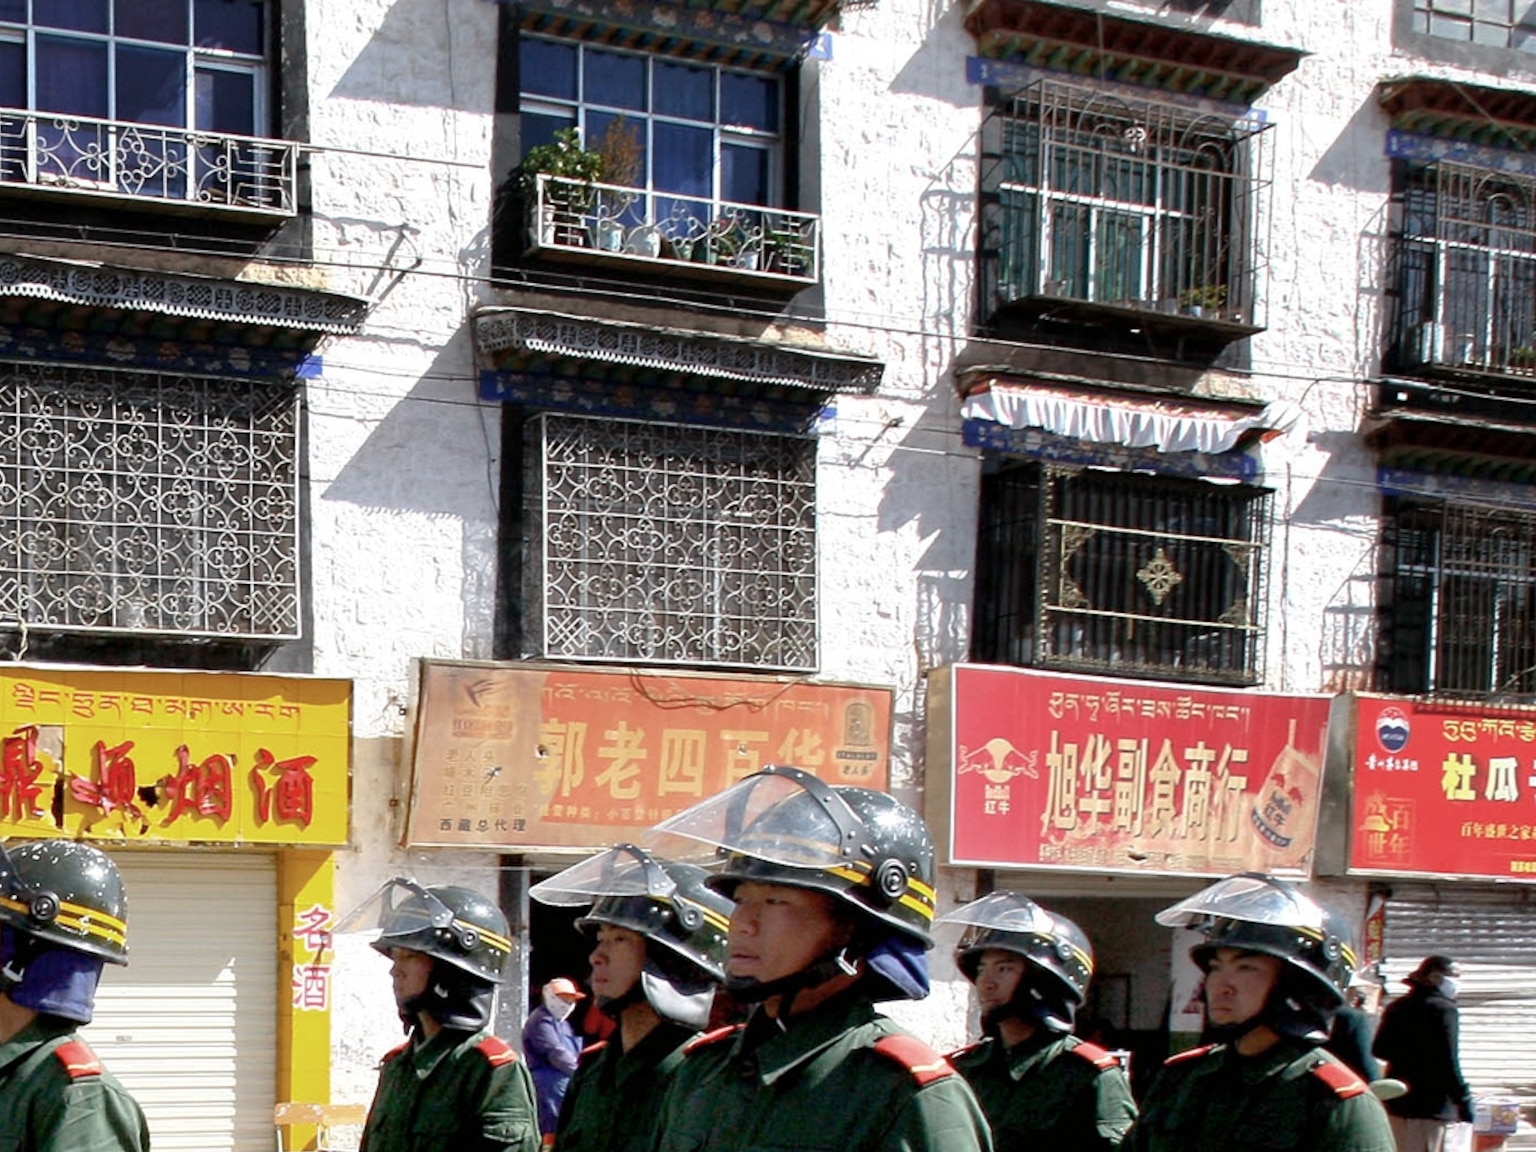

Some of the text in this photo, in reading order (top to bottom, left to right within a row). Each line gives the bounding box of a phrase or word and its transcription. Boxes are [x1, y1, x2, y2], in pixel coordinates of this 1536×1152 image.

[532, 717, 826, 800] 郭老四百货
[1041, 730, 1249, 841] 旭华副食商行
[1441, 752, 1536, 802] 杜瓜
[439, 818, 527, 832] 西藏总代理
[983, 800, 1011, 816] 红牛
[293, 906, 332, 1010] 名酒
